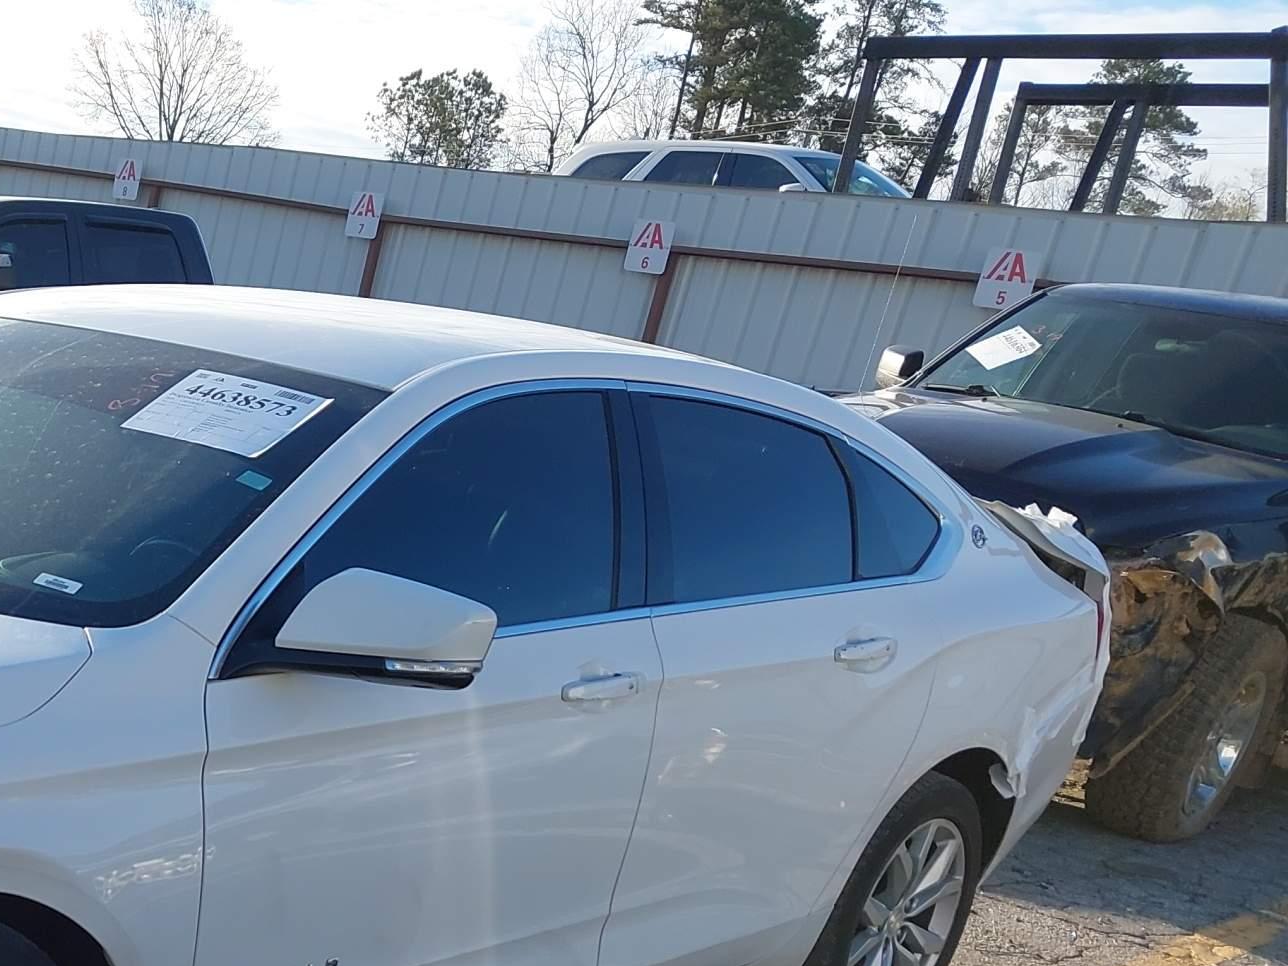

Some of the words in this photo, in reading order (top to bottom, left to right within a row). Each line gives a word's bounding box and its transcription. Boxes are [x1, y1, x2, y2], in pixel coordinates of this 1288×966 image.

[122, 185, 128, 196] 8
[358, 223, 366, 234] 7
[641, 256, 650, 269] 6
[995, 290, 1007, 305] 5
[184, 383, 298, 417] 44638573
